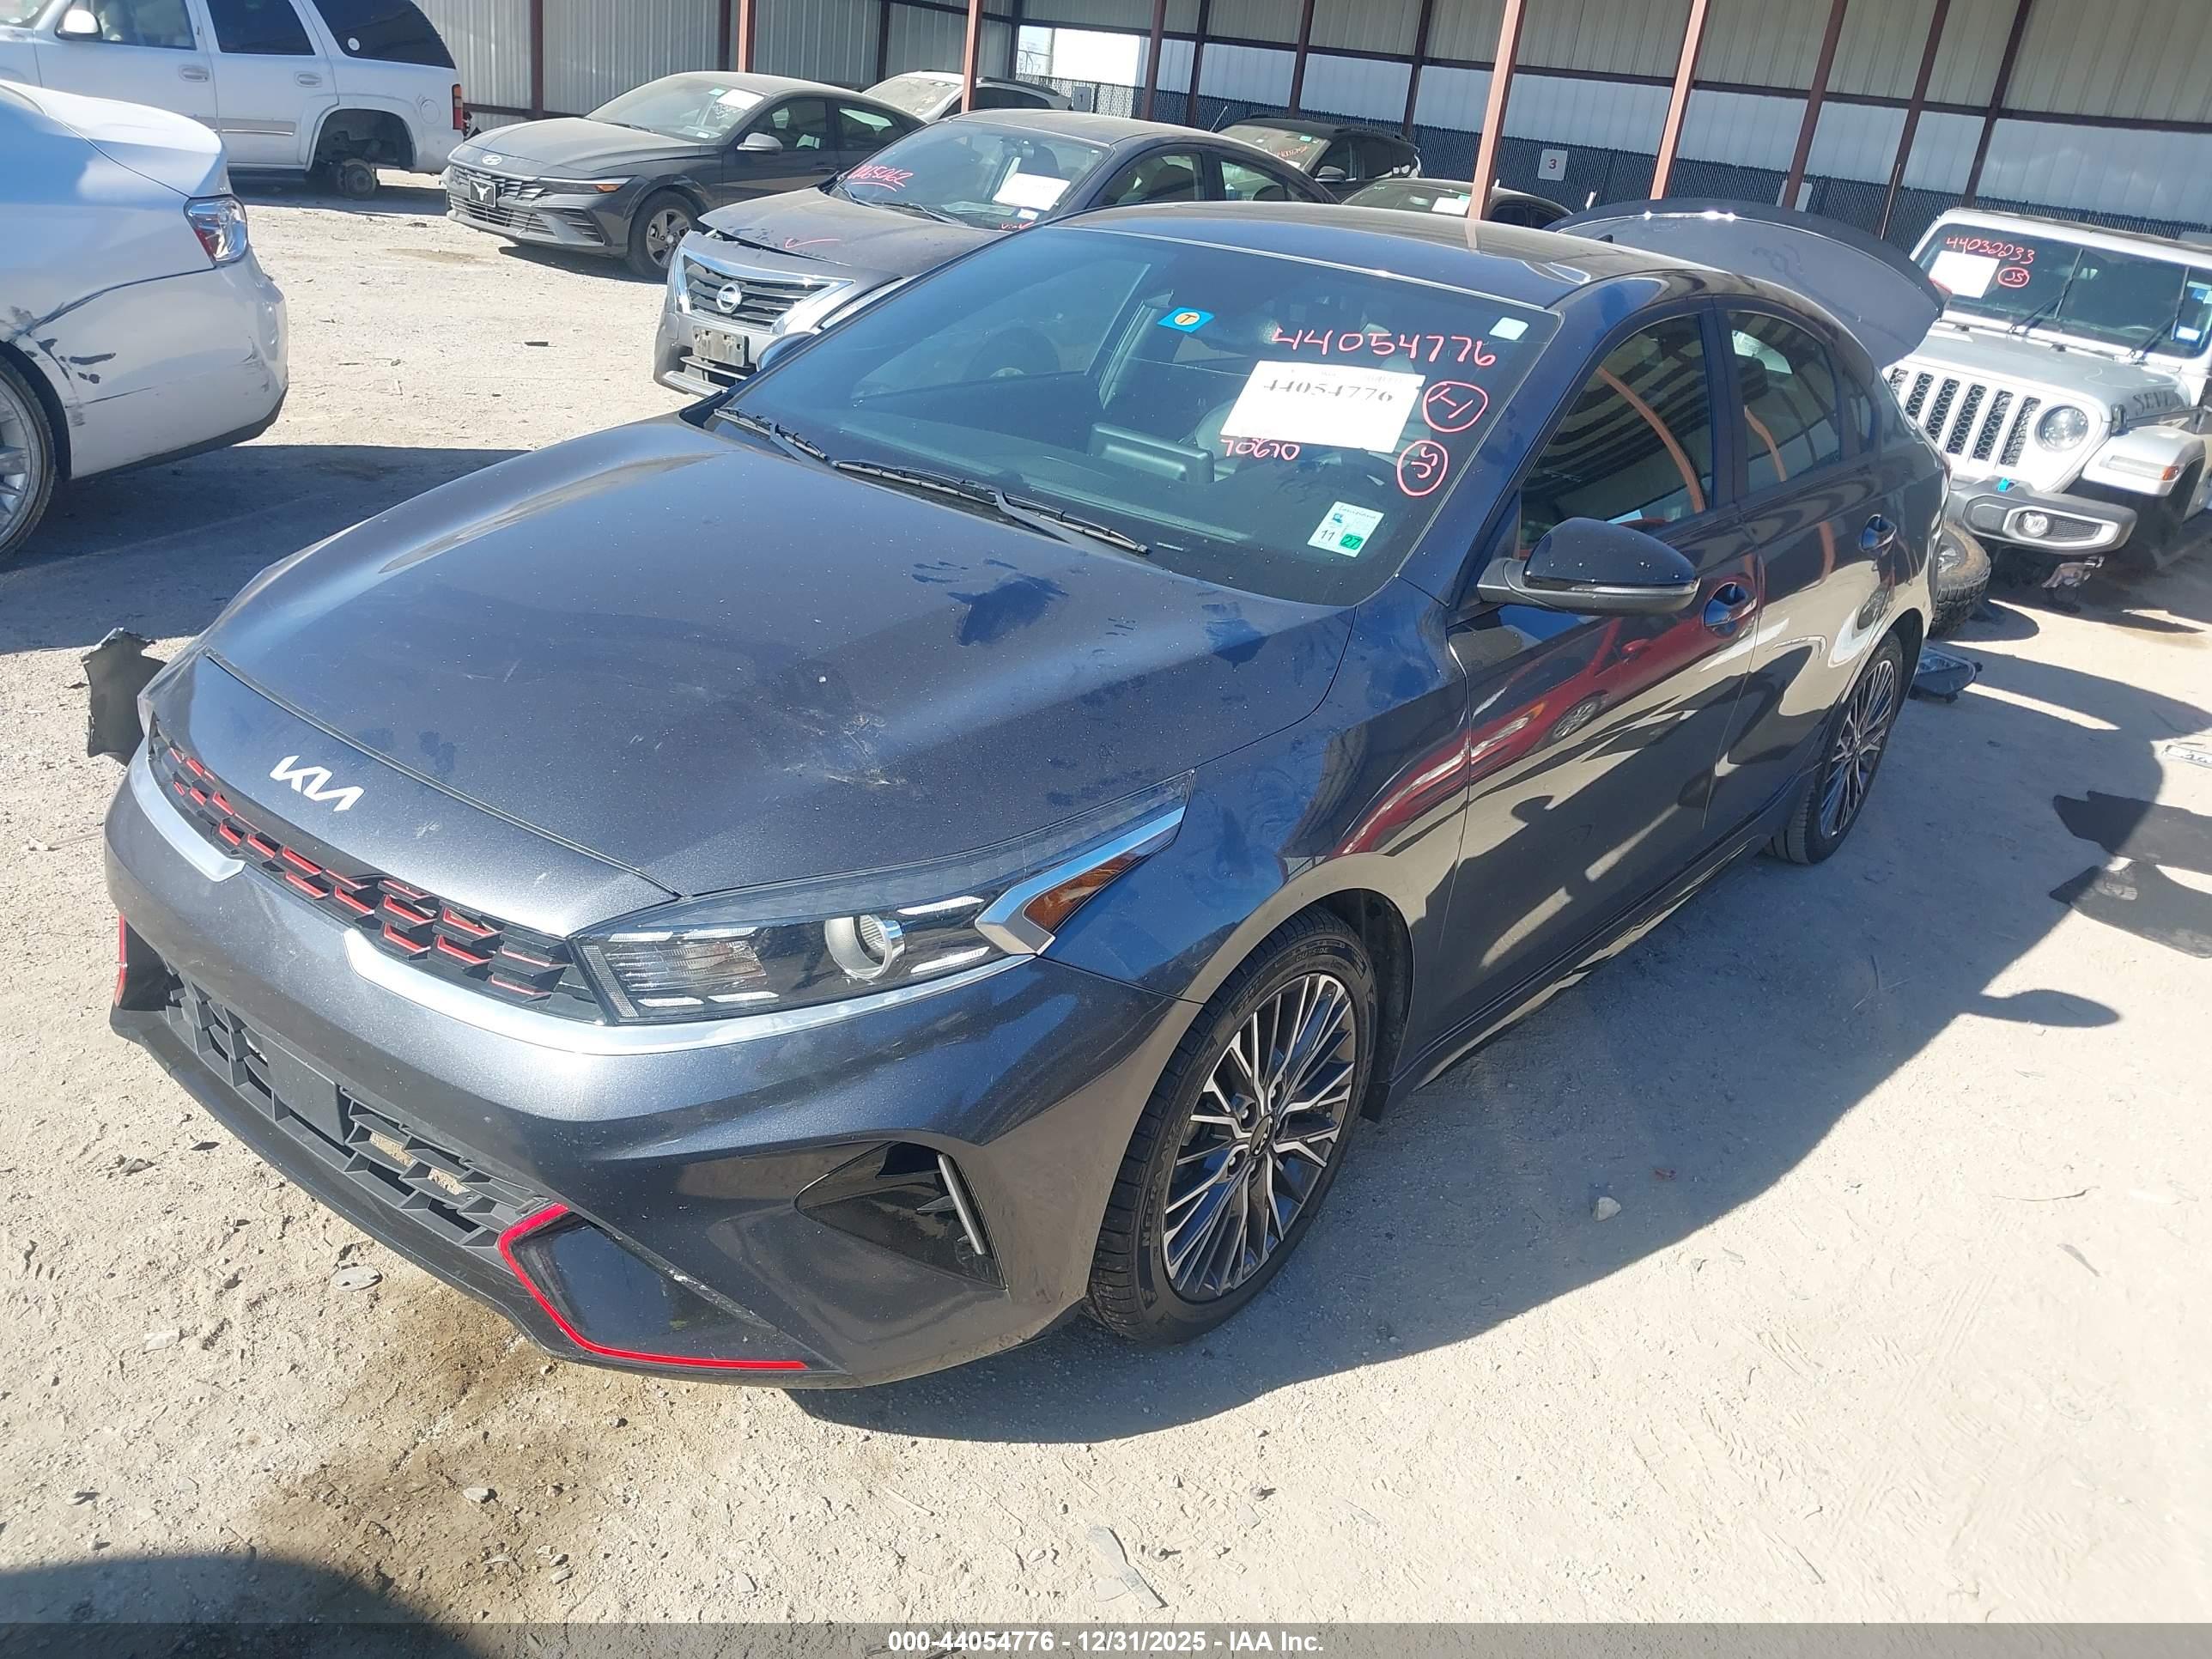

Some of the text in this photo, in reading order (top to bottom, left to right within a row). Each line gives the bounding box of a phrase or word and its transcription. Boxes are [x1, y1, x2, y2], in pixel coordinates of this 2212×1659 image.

[1548, 158, 1557, 170] 3
[1272, 327, 1497, 367] 44054776
[1321, 529, 1362, 549] 11 27
[270, 756, 365, 811] KIA
